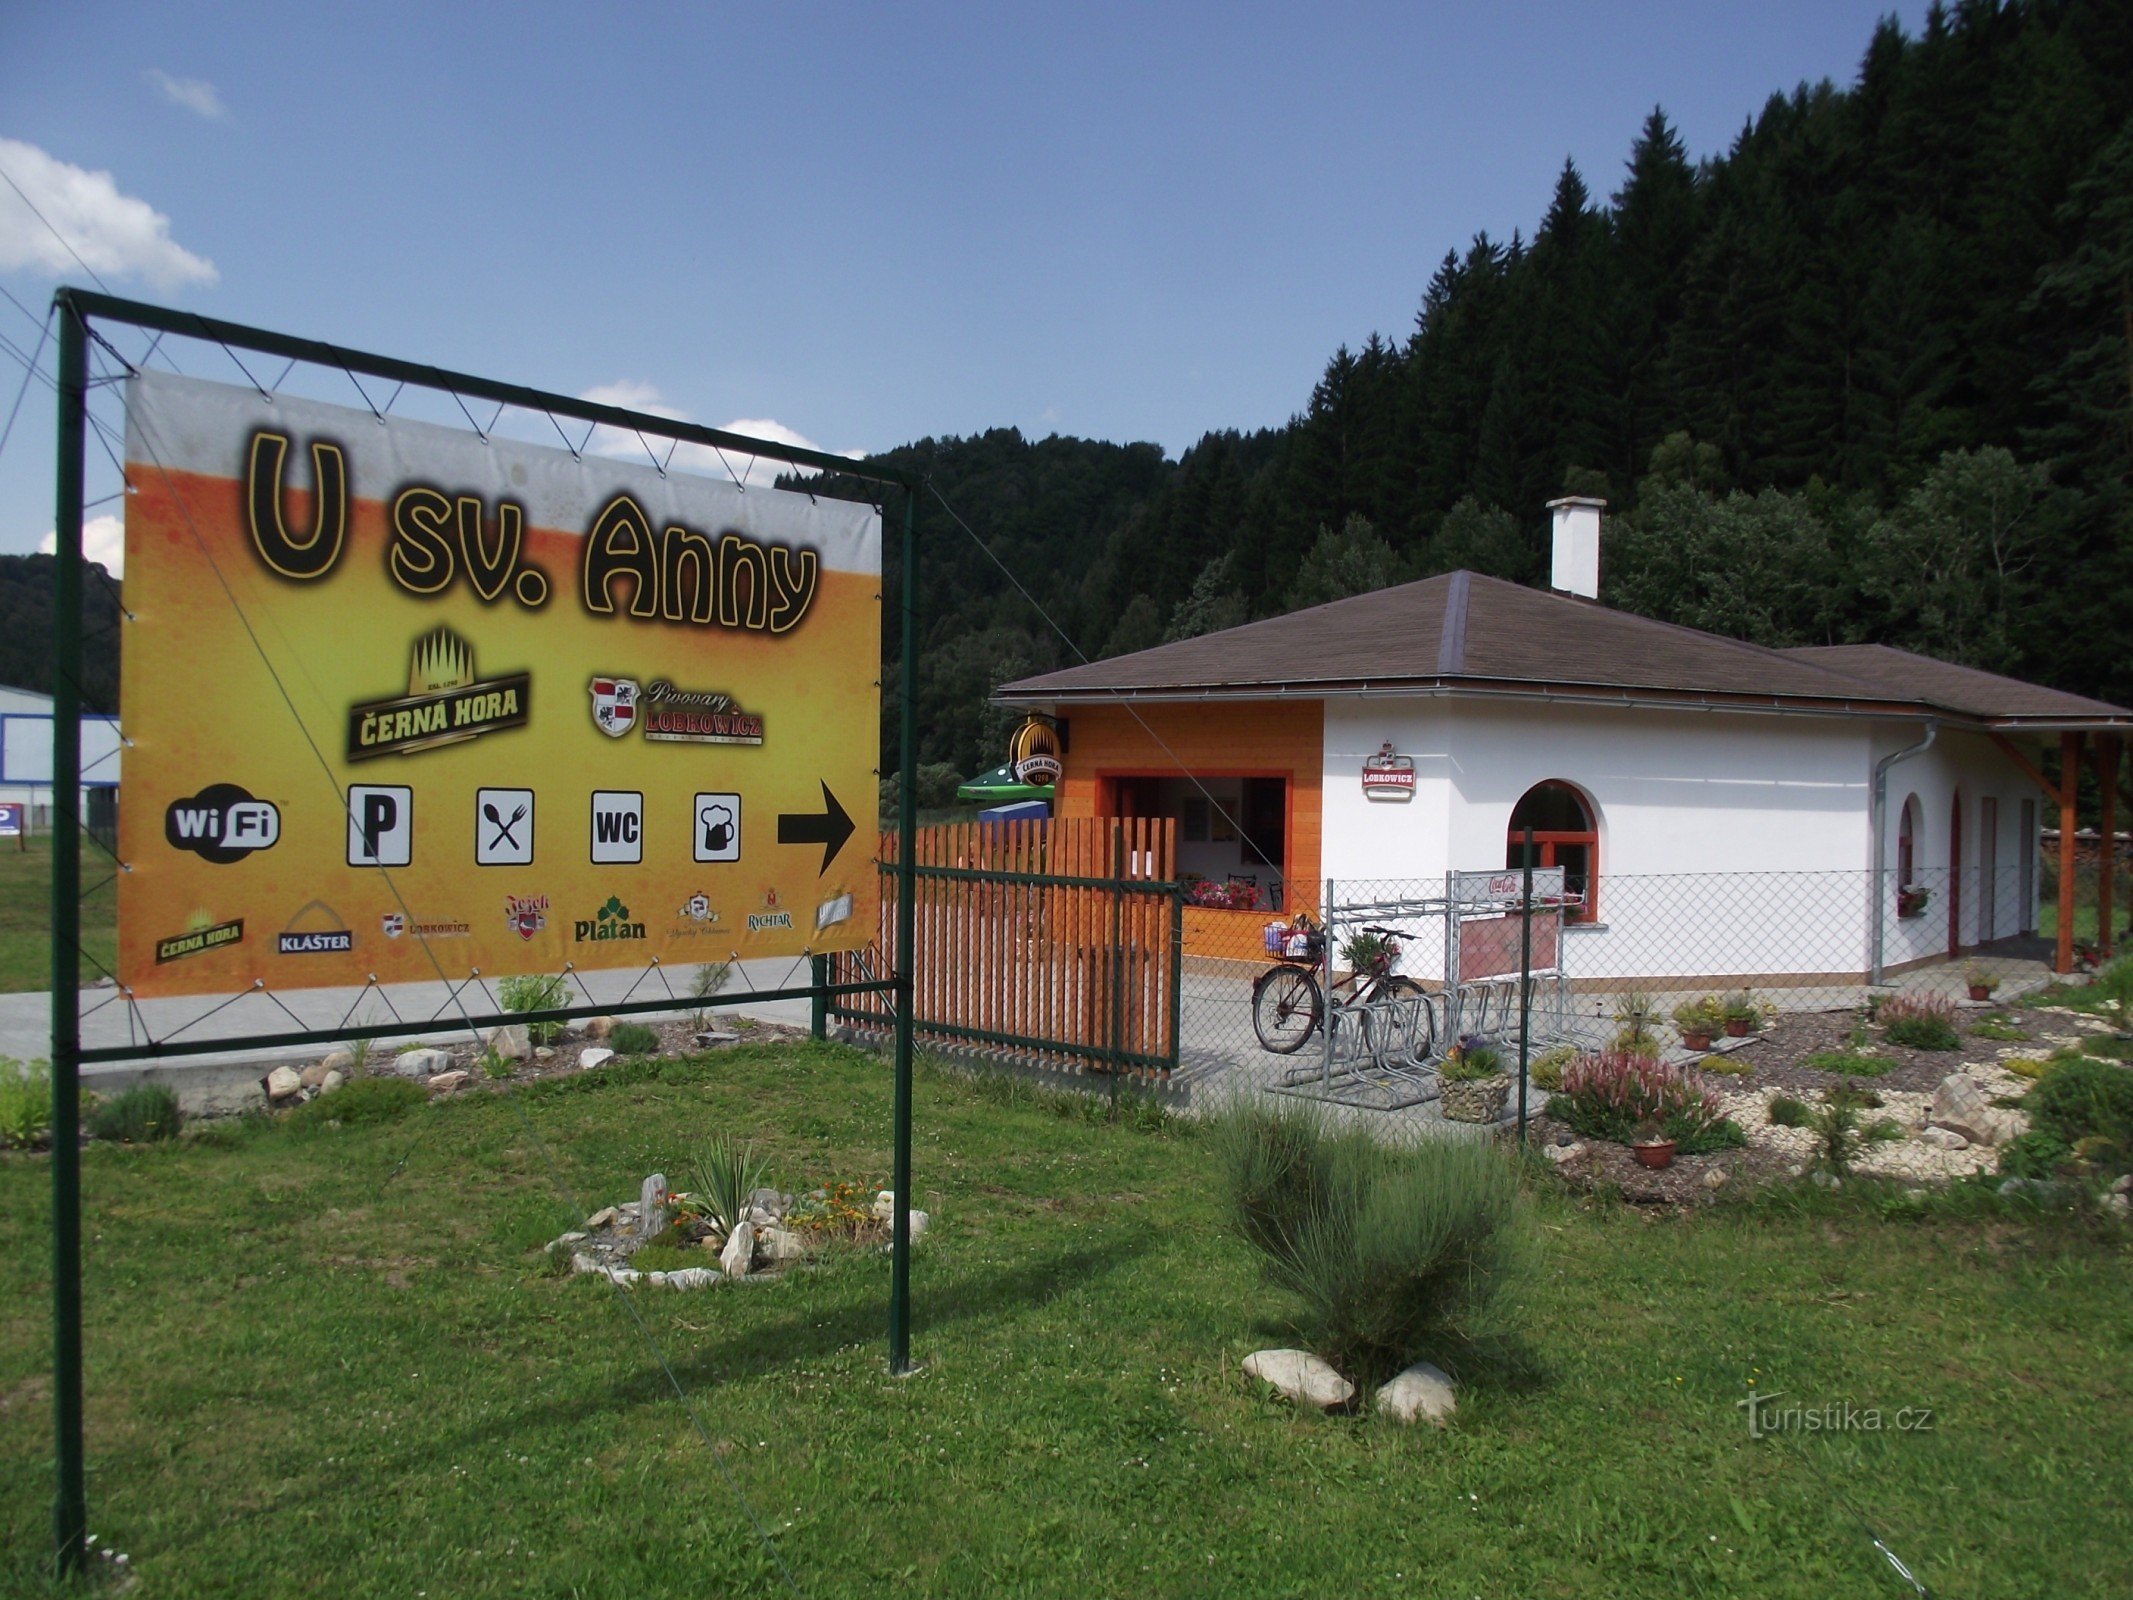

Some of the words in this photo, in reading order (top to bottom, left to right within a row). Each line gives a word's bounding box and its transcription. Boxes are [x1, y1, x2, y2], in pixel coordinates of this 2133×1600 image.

[248, 432, 346, 580] U
[391, 487, 548, 606] sv.
[584, 496, 817, 633] Anny
[644, 681, 730, 712] Pivovary
[360, 700, 448, 746] ČERNÁ
[454, 689, 518, 726] HORA
[646, 711, 761, 735] LOBKOWICZ
[1363, 774, 1413, 783] LOBKOWICZ
[363, 794, 397, 857] P
[596, 811, 639, 844] WC
[206, 925, 239, 946] HORA
[410, 923, 470, 934] LOBKOWICZ
[575, 918, 647, 943] Platan
[281, 933, 350, 951] KLÁŠTER
